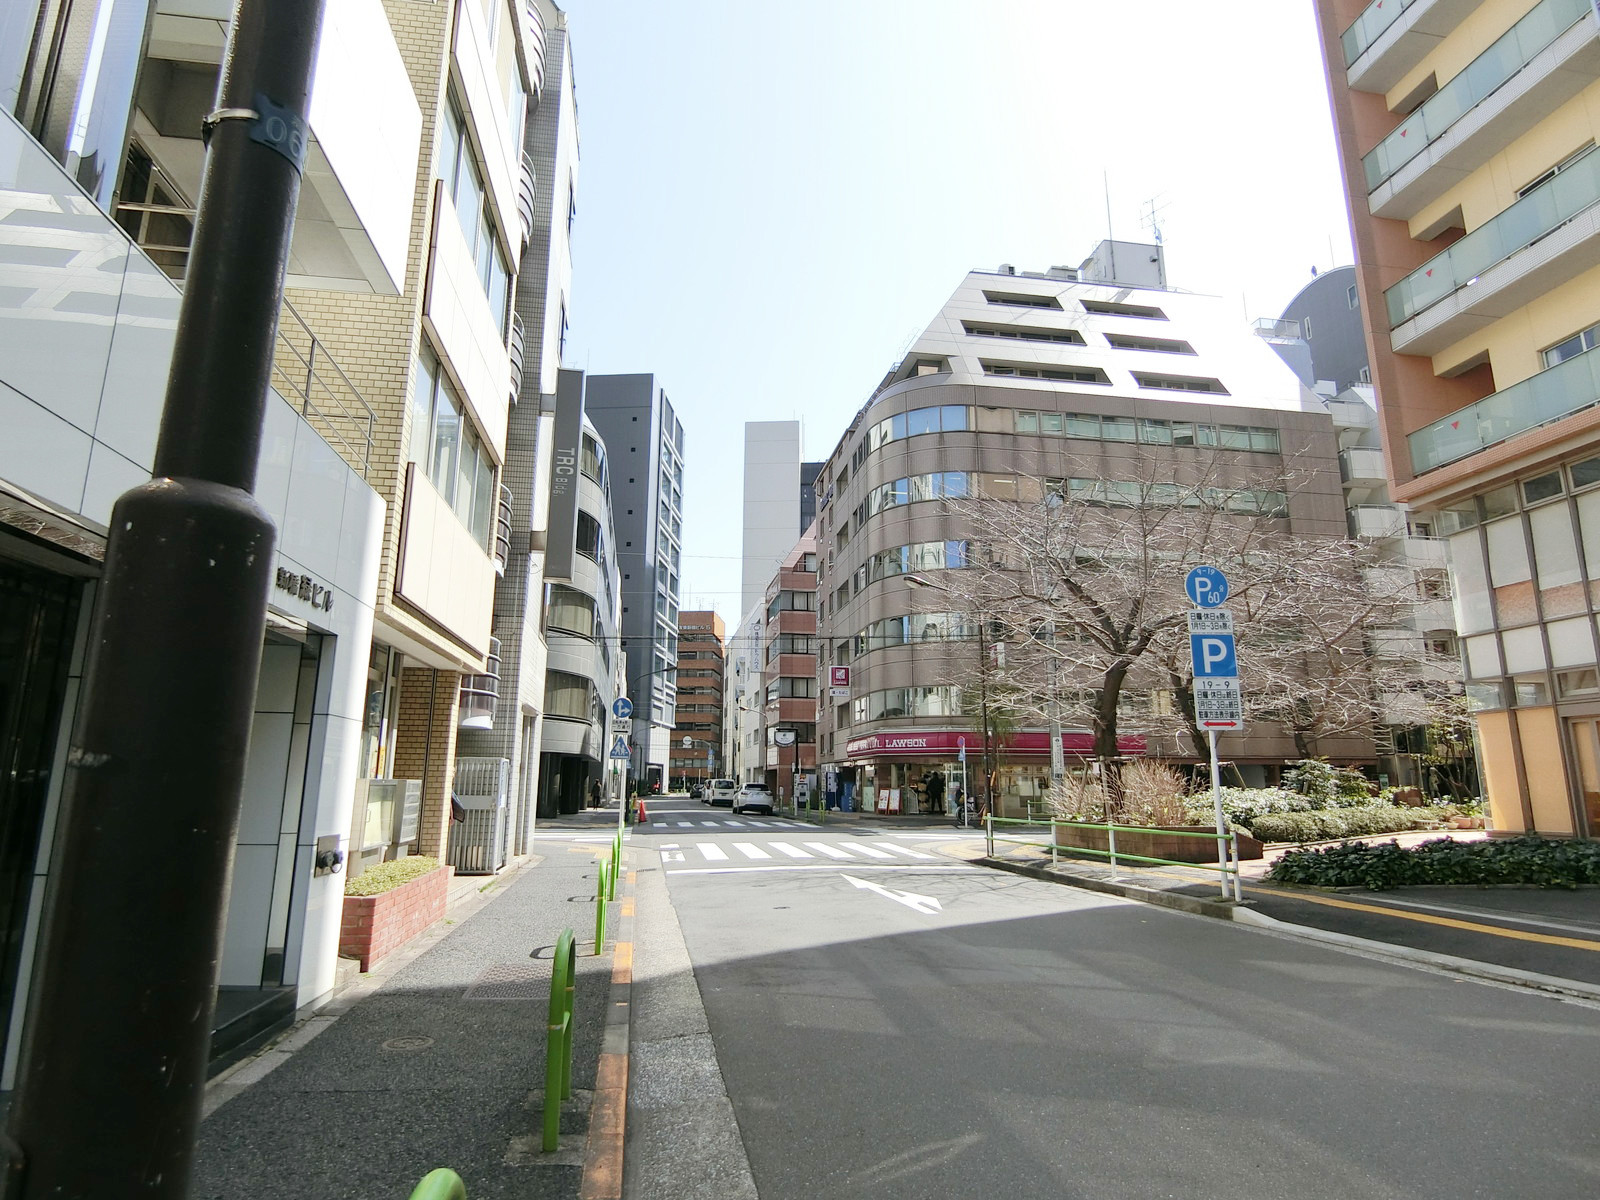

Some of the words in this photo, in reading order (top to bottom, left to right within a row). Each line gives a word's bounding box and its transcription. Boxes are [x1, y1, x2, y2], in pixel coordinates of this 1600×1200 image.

[556, 448, 575, 475] TRC
[1194, 577, 1211, 603] P
[1201, 638, 1227, 674] P
[885, 739, 927, 748] LAWSON
